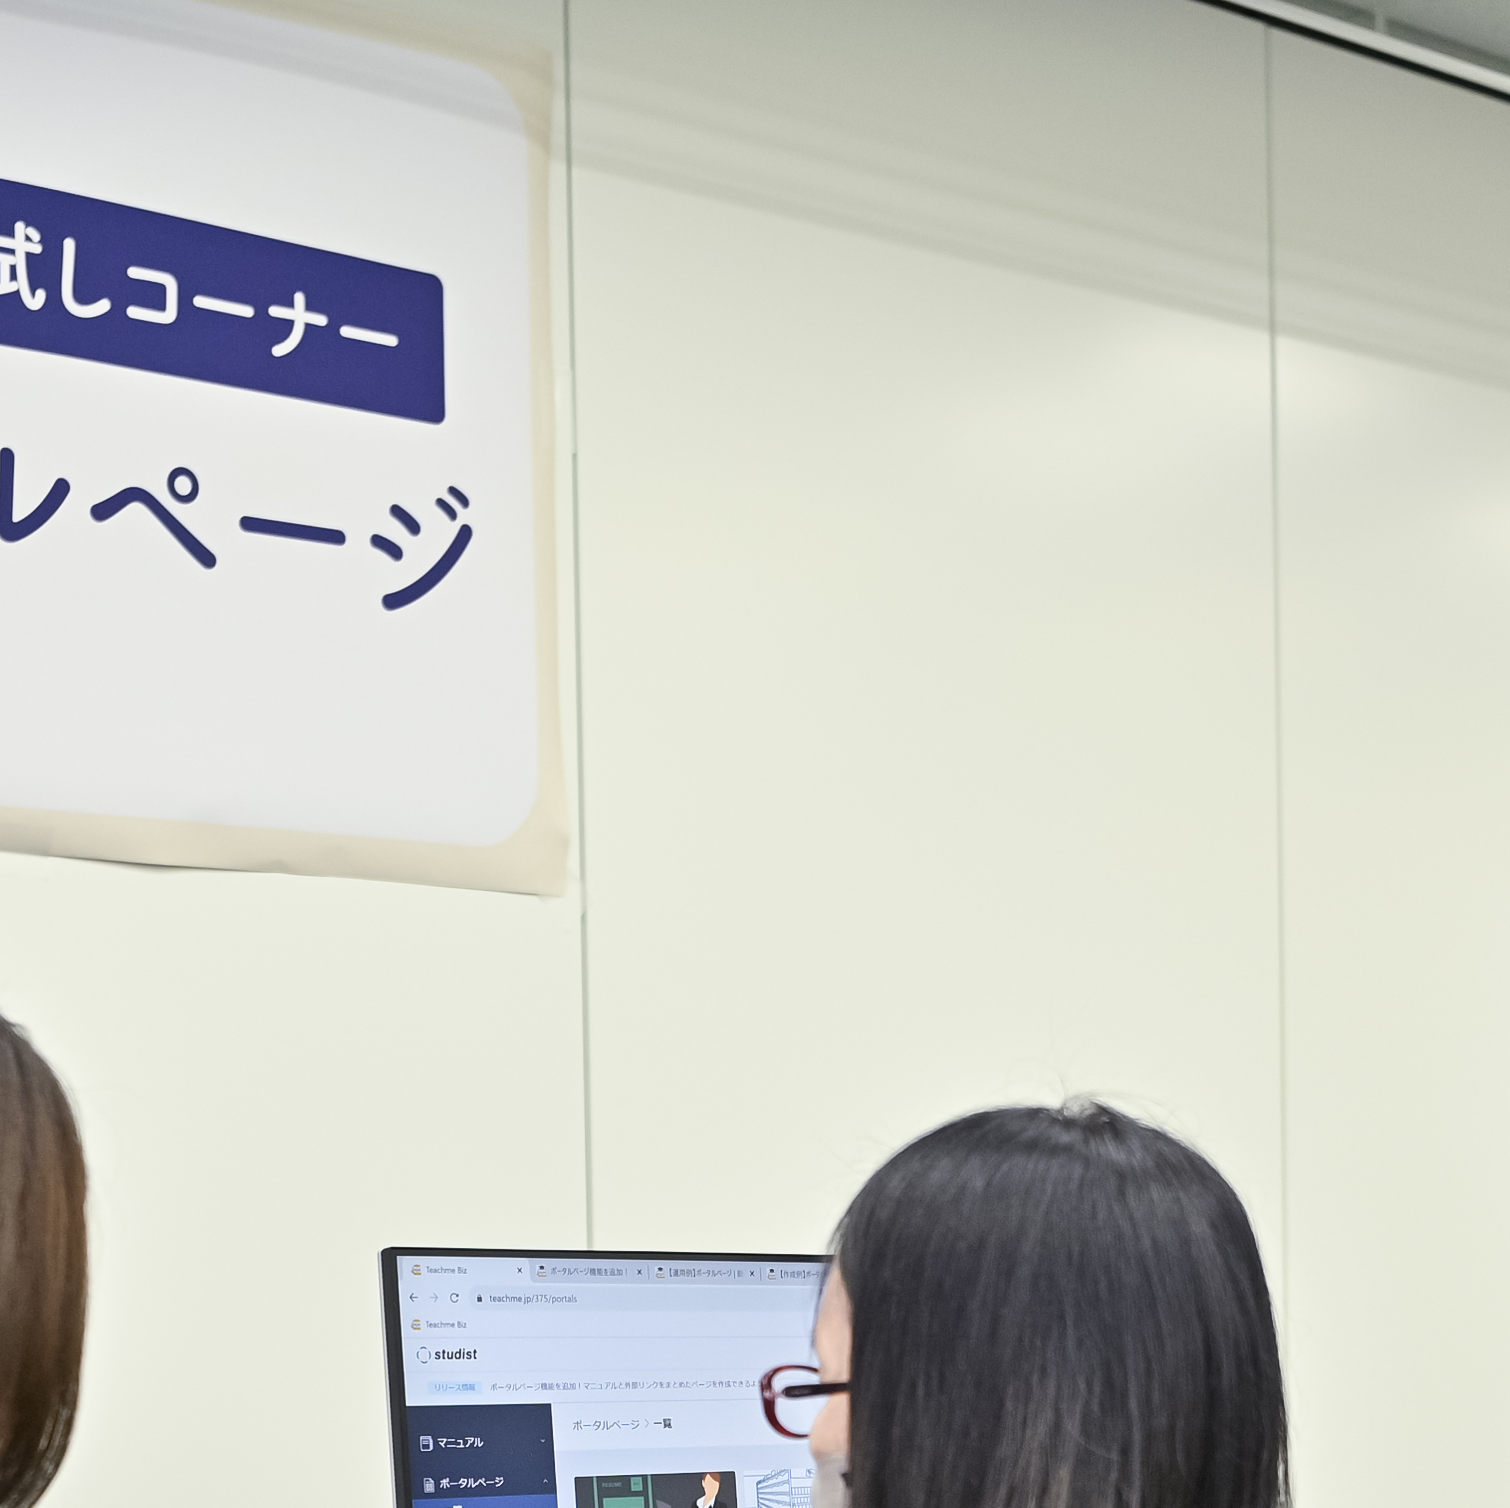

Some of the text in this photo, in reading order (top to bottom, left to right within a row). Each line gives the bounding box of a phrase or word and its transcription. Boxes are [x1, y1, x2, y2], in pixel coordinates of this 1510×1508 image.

[434, 1348, 478, 1360] studist
[572, 1418, 673, 1431] ポータルページ 一覧
[437, 1437, 484, 1448] マニュアル
[440, 1477, 504, 1489] ポータルページ
